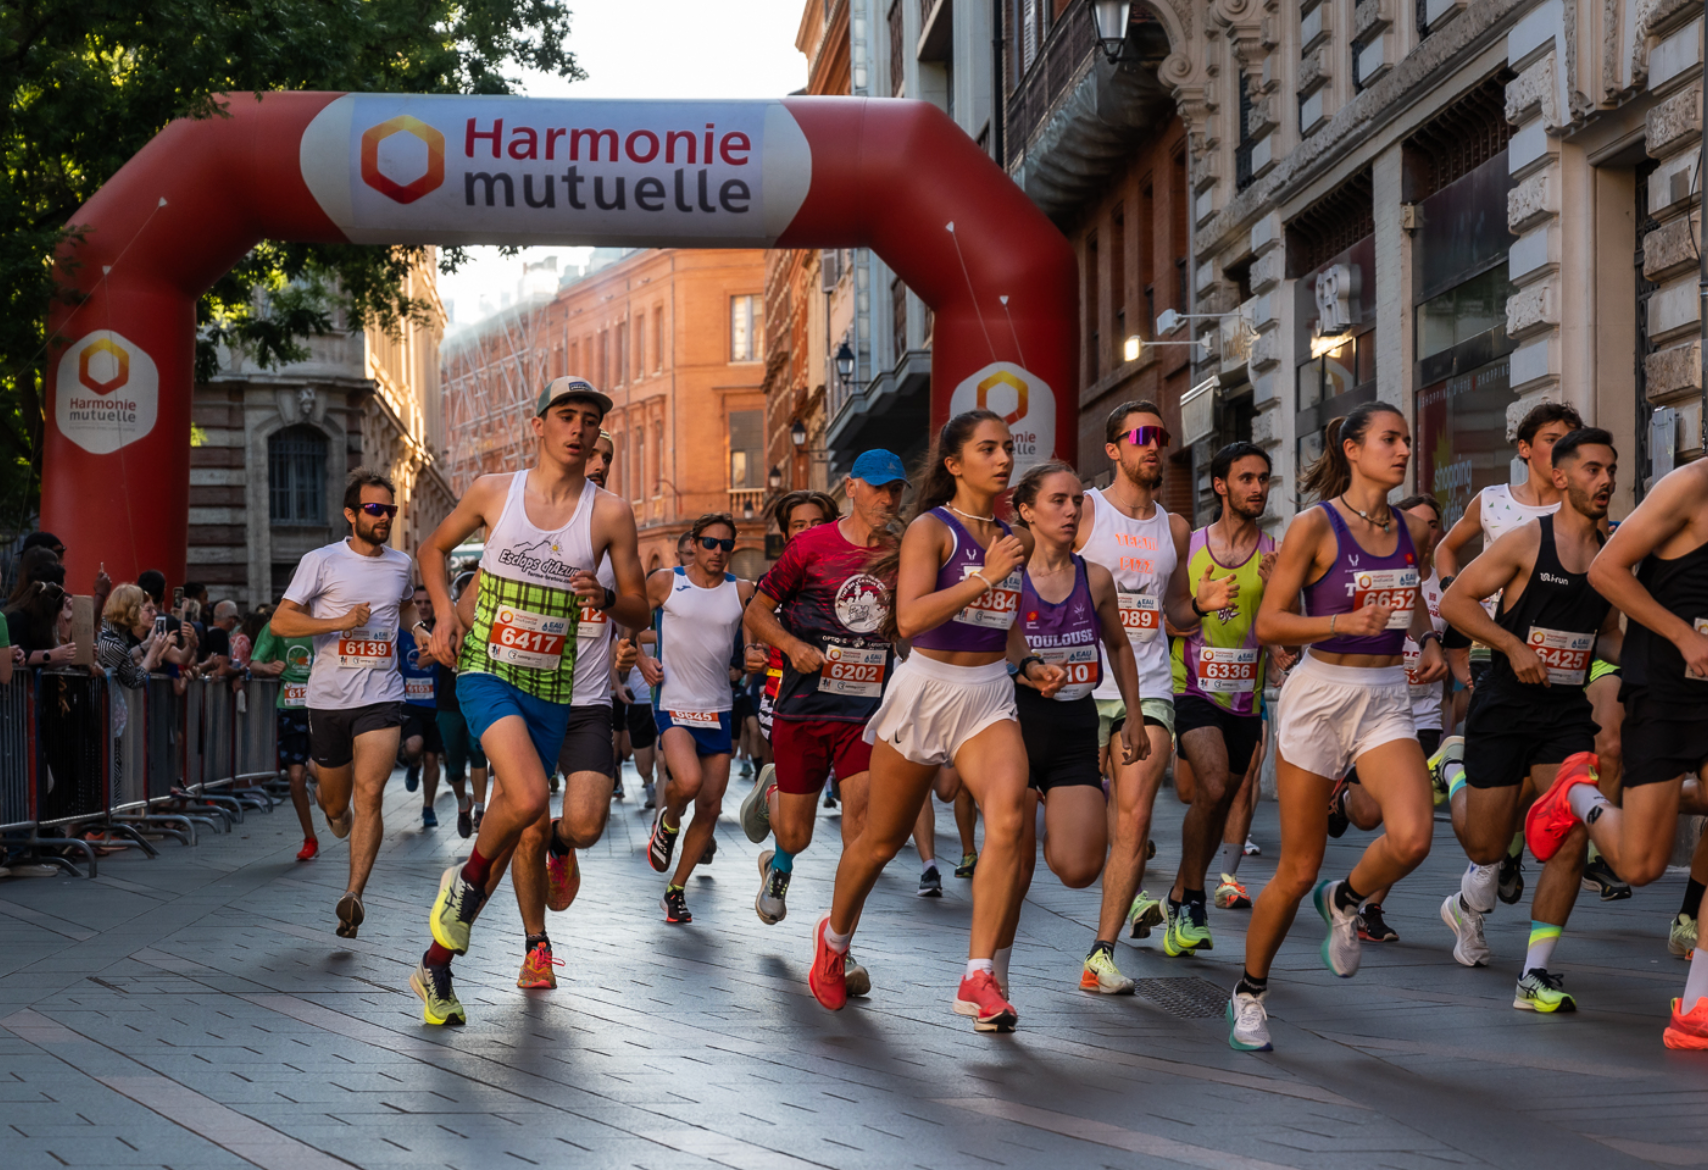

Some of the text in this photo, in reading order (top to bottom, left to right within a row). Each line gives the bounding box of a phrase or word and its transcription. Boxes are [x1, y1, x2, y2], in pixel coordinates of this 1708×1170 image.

[464, 117, 752, 166] Harmonie
[464, 165, 752, 213] mutuelle
[69, 397, 137, 411] Harmonie
[69, 409, 136, 422] mutuelle
[1010, 431, 1036, 443] onie
[1434, 453, 1472, 500] shopping
[1442, 496, 1464, 532] d'été
[1115, 532, 1159, 551] TEAM
[498, 548, 541, 572] Esclops
[1120, 556, 1155, 574] PIZZ
[971, 591, 1017, 612] 384
[1363, 590, 1416, 609] 6652
[581, 607, 602, 622] 12
[1119, 610, 1152, 627] 089
[549, 621, 564, 630] EAU
[501, 627, 558, 653] 6417
[1024, 628, 1095, 648] TOULOUSE
[345, 641, 388, 656] 6139
[1536, 648, 1585, 669] 6425
[831, 663, 878, 681] 6202
[1066, 664, 1088, 682] 10
[1206, 663, 1251, 678] 6336
[289, 688, 307, 699] 612
